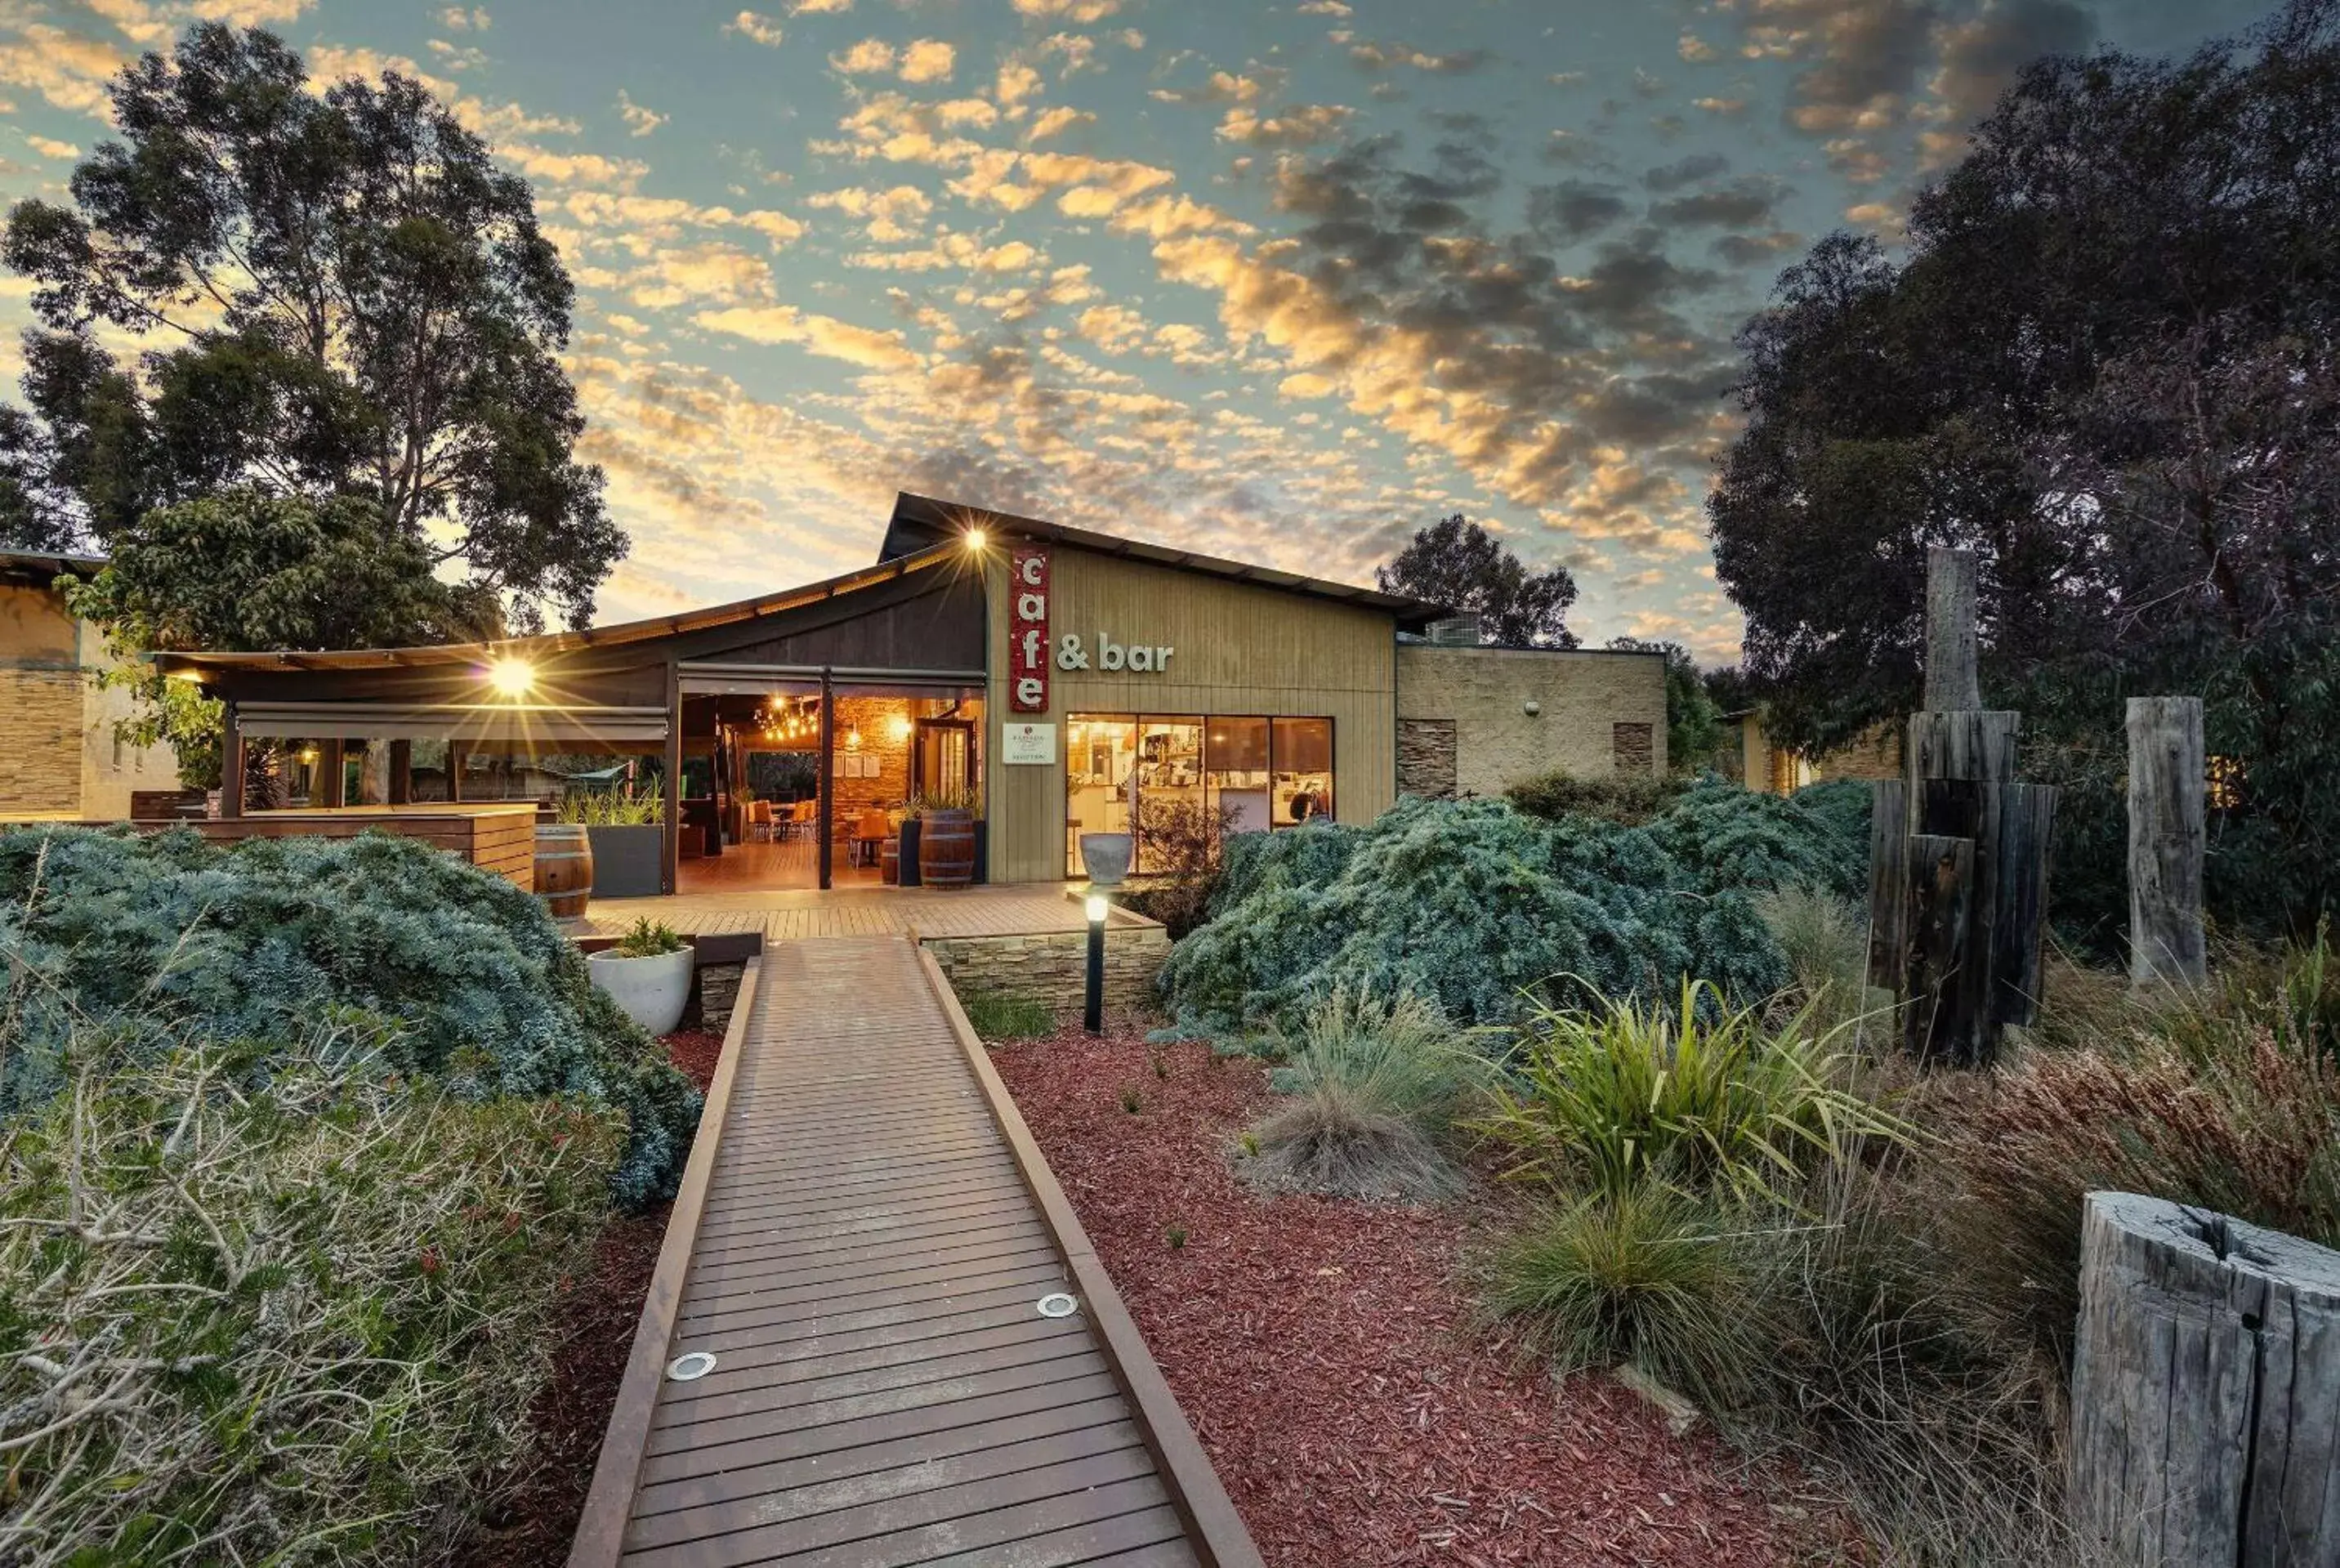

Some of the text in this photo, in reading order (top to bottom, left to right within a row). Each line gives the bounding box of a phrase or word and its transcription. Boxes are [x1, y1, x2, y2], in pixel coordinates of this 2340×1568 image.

[1017, 557, 1045, 704] cafe
[1057, 632, 1174, 672] & bar
